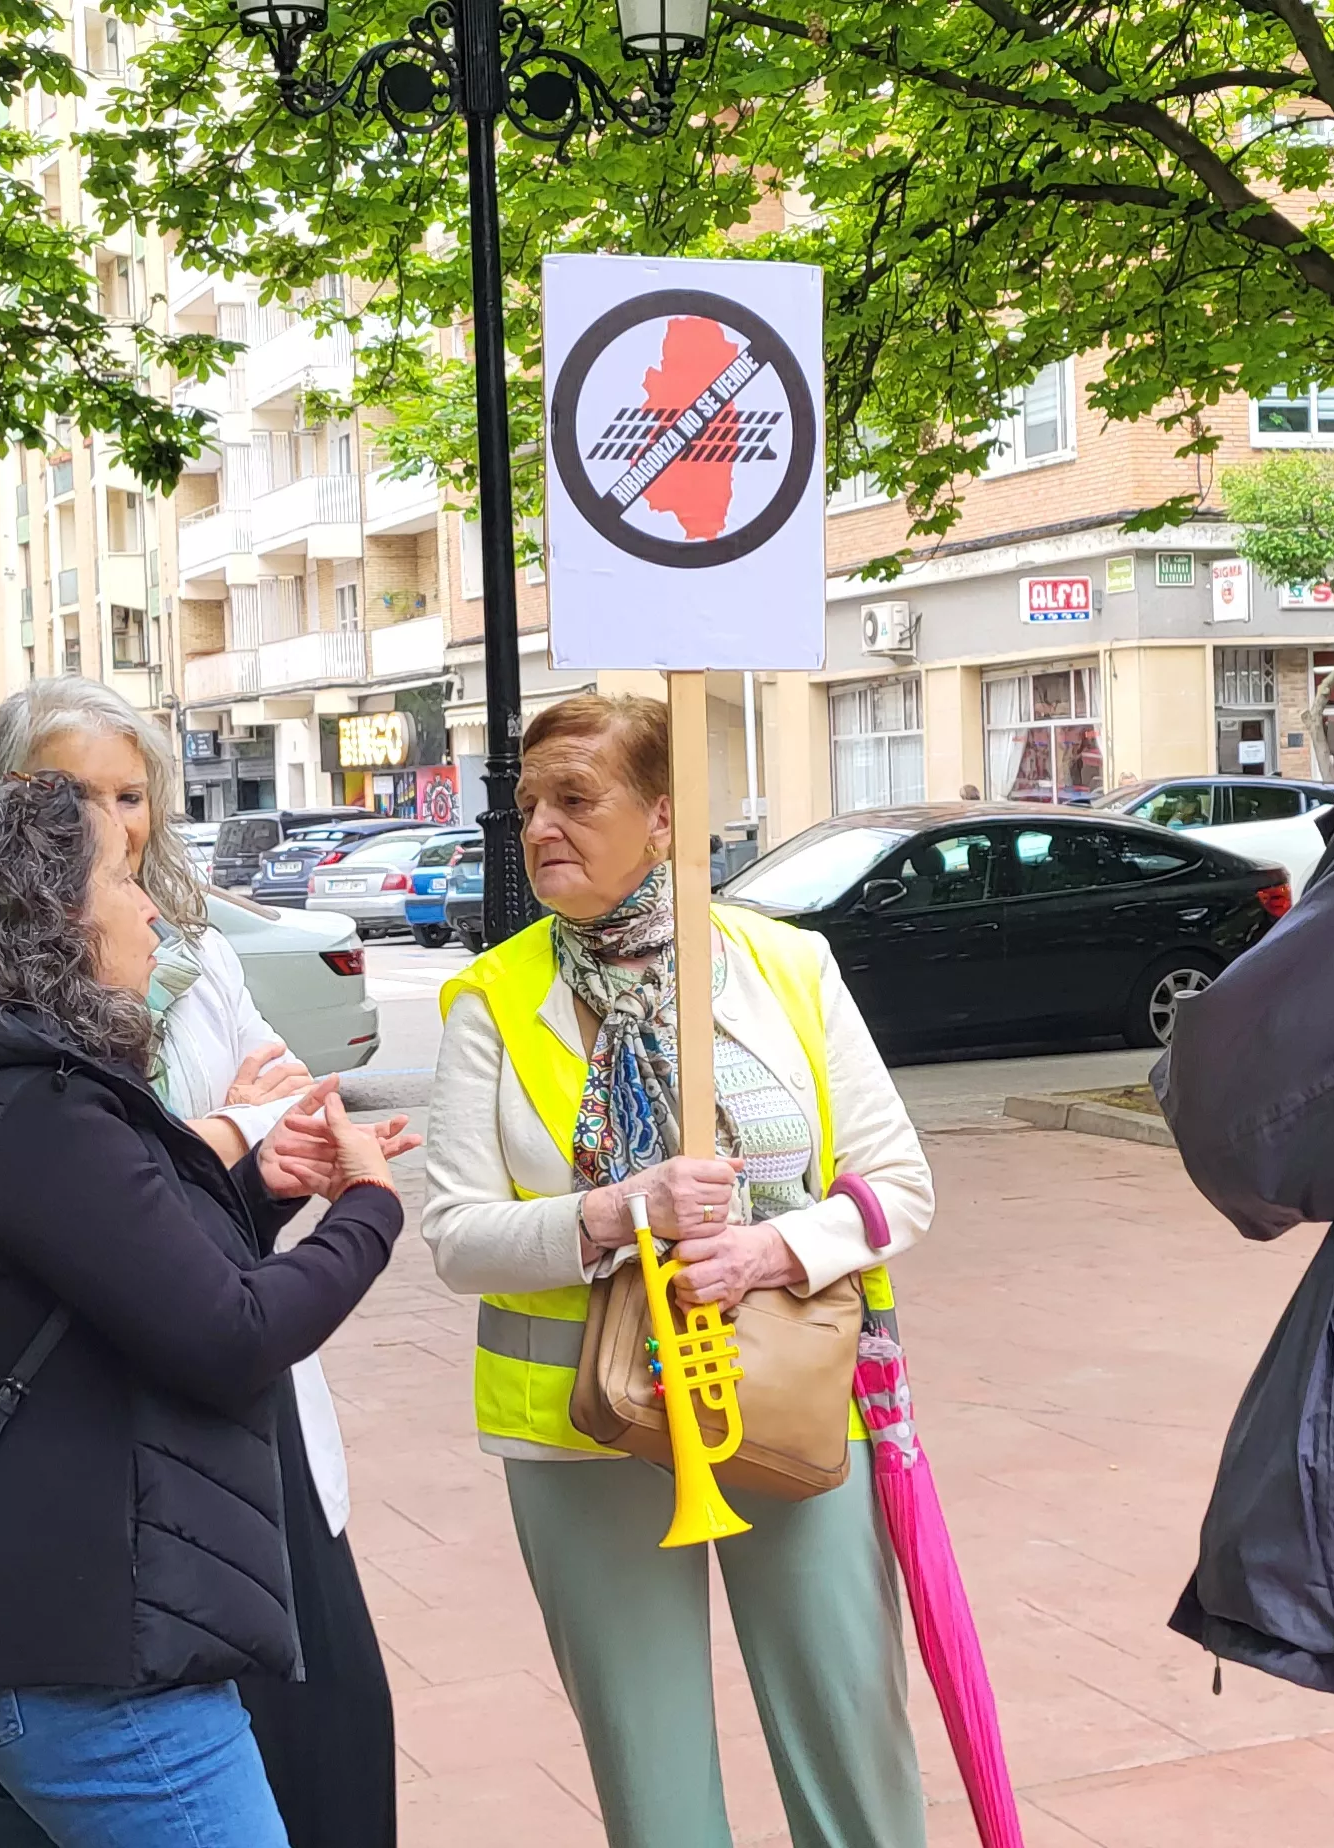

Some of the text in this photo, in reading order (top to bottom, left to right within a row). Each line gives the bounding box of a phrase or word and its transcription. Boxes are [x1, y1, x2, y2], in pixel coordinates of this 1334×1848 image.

[610, 349, 760, 506] RIBAGORZA NO SE VENDE
[1212, 565, 1243, 580] SIGMA
[1031, 582, 1087, 609] ALFA
[338, 711, 408, 767] BINGO
